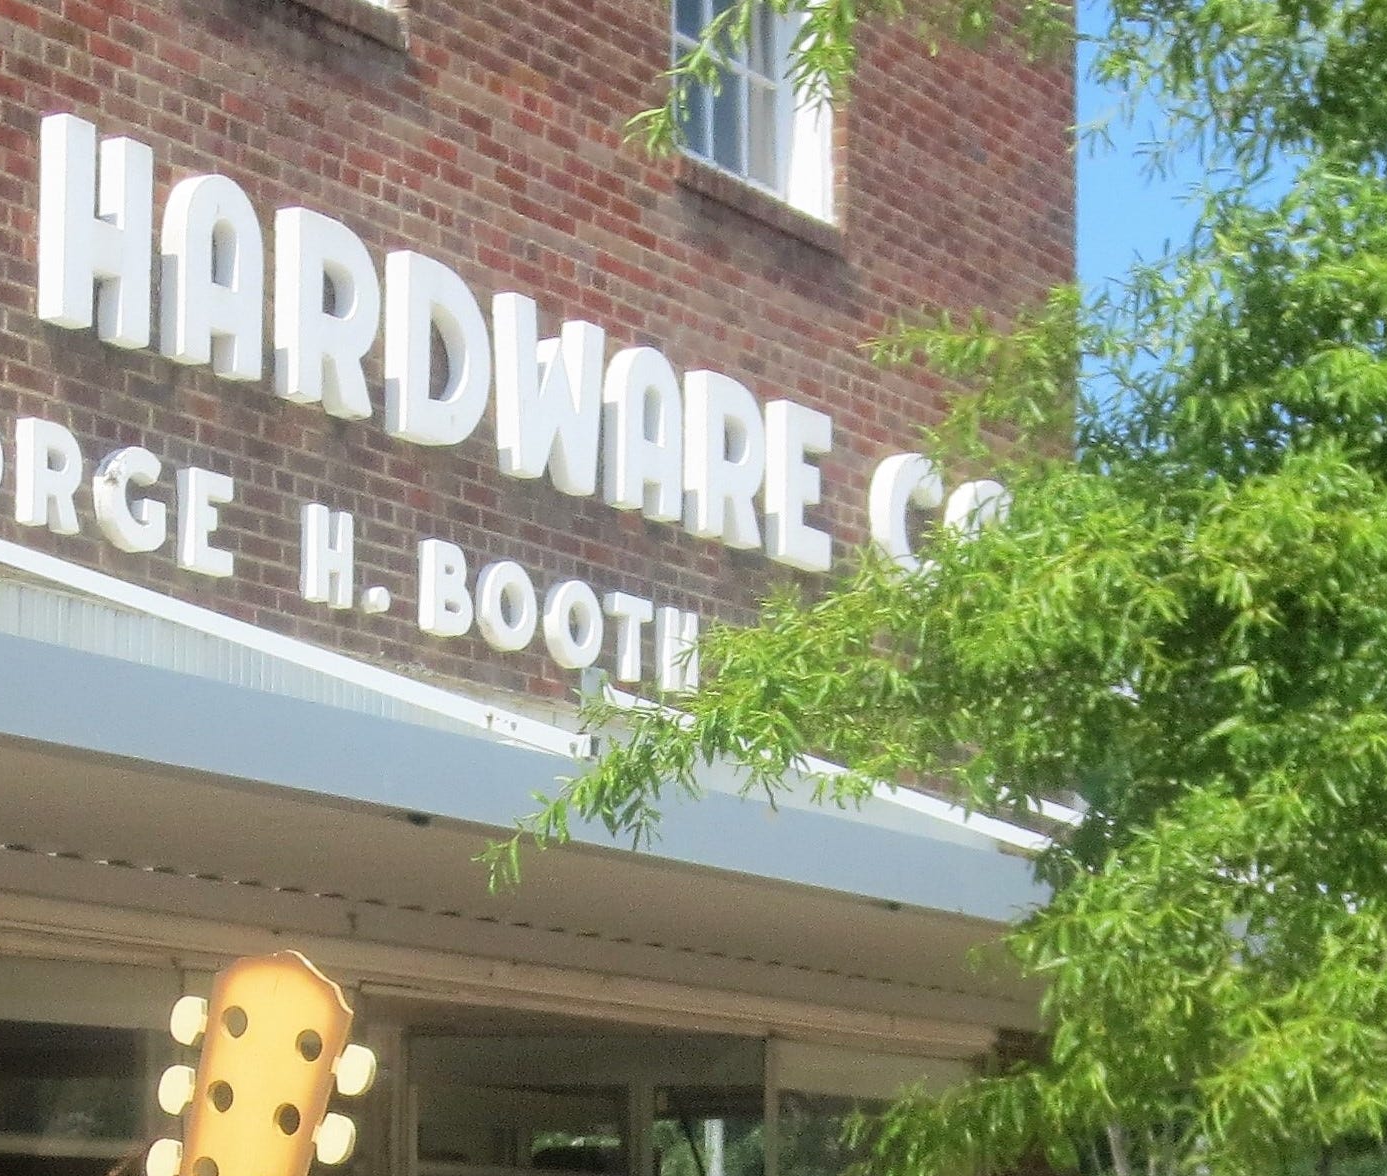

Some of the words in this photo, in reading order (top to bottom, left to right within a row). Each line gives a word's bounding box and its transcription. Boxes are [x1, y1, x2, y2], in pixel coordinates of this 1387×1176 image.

[38, 112, 833, 571] HARDWARE
[300, 503, 392, 616] H.
[417, 538, 700, 693] BOOTH
